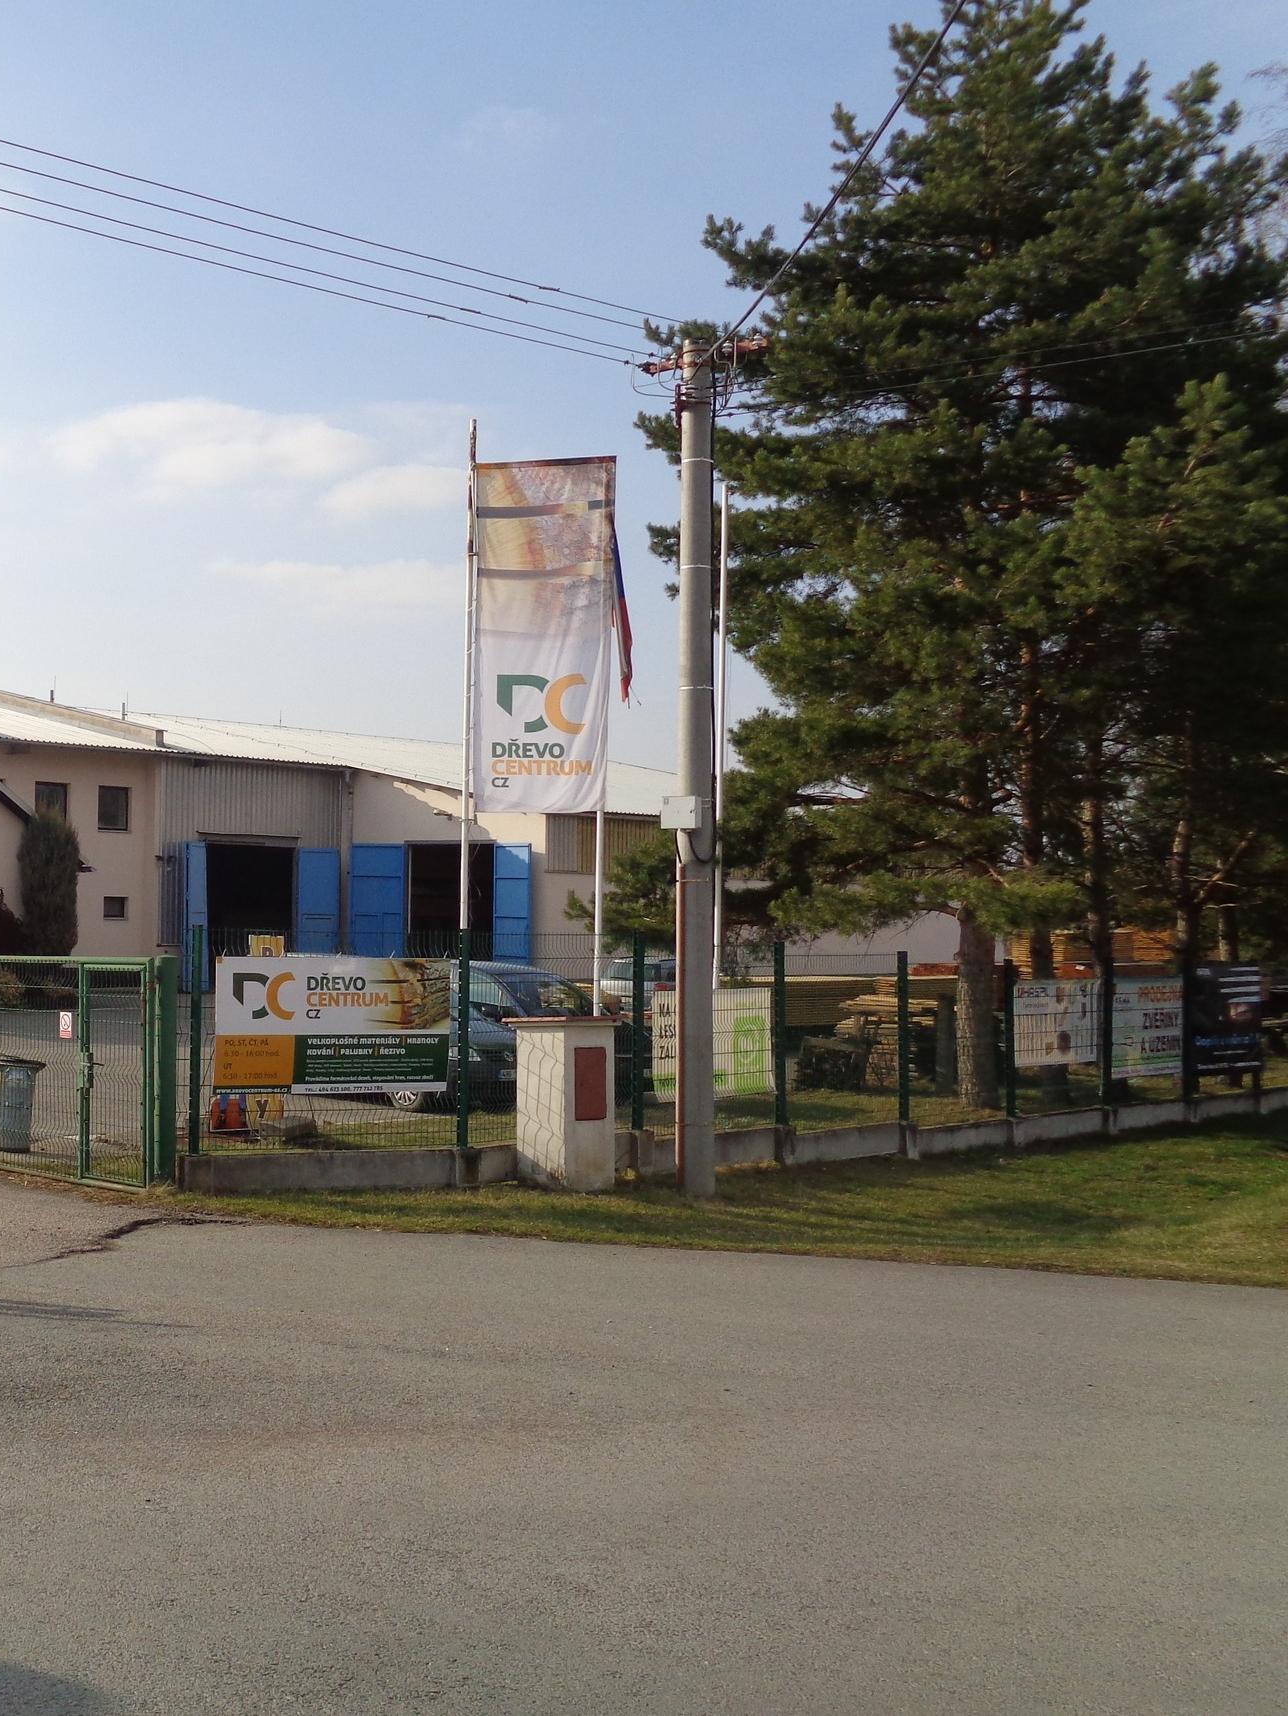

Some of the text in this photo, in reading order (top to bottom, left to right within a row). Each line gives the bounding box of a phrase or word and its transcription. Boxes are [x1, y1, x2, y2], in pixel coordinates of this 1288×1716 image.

[491, 738, 565, 759] DŘEVO
[491, 759, 592, 776] CENTRUM
[491, 777, 509, 788] CZ
[306, 972, 366, 991] DŘEVO
[306, 991, 389, 1008] CENTRUM
[305, 1008, 321, 1019] CZ
